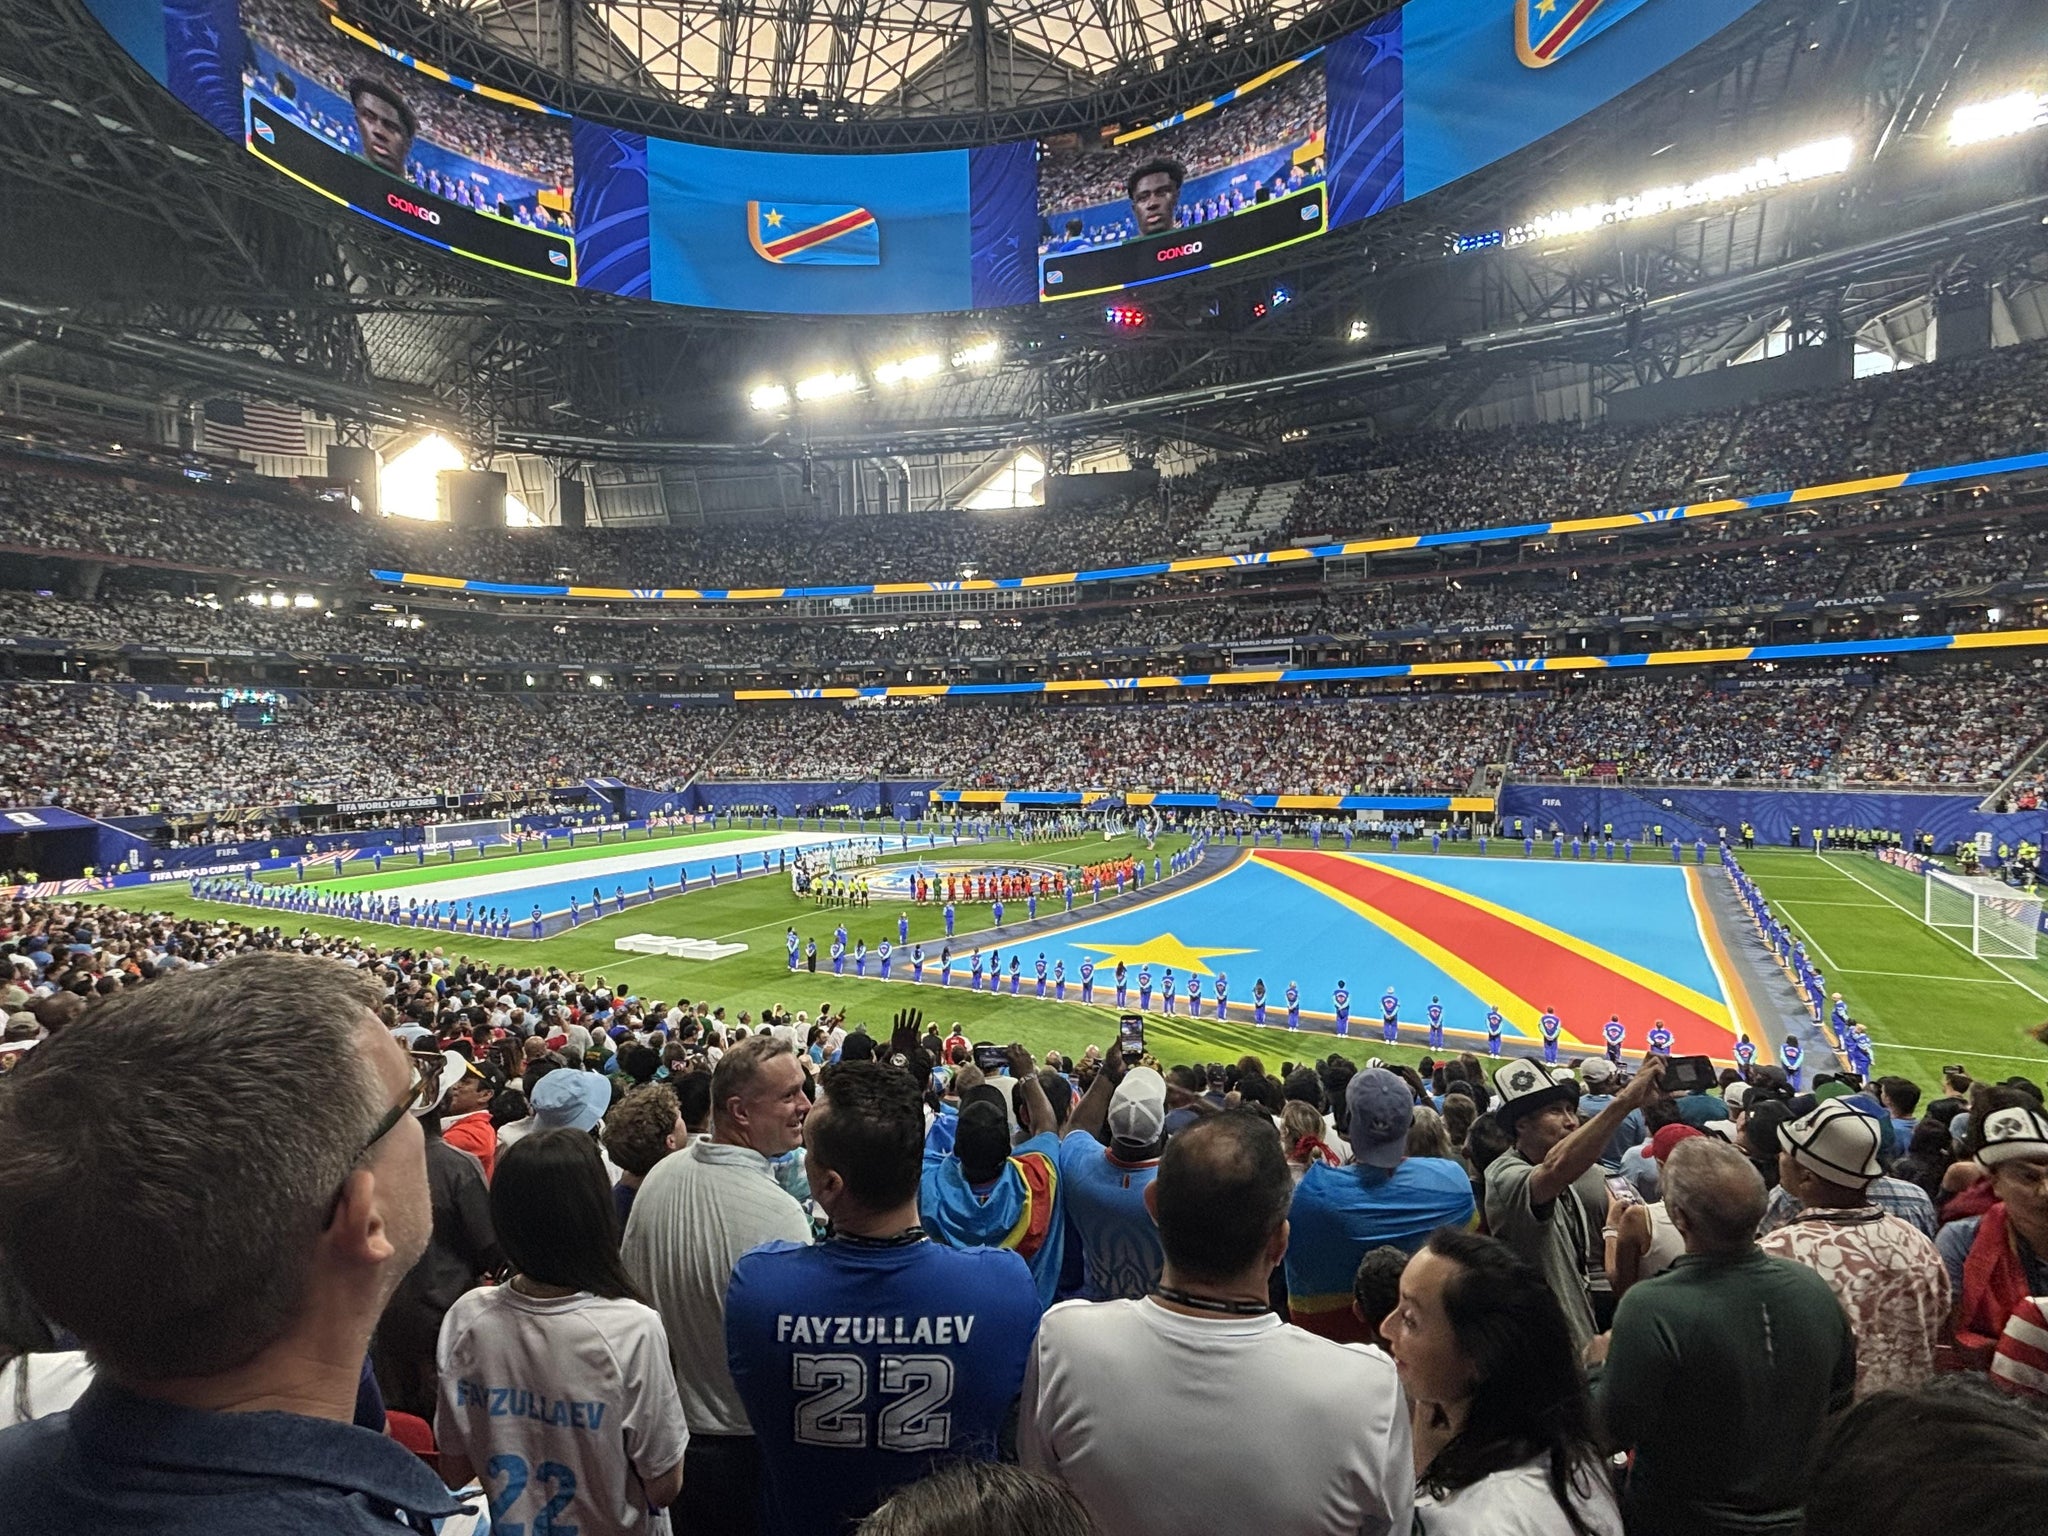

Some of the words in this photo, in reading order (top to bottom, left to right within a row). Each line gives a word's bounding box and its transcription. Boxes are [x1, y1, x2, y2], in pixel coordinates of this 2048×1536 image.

[387, 193, 441, 225] CONGO
[1157, 241, 1203, 261] CONGO
[1814, 595, 1885, 607] ATLANTA
[1462, 624, 1514, 632] ATLANTA
[1057, 650, 1092, 658] ATLANTA
[337, 804, 358, 812] FIFA
[357, 801, 390, 811] WORLD
[390, 800, 408, 808] CUP
[408, 797, 437, 807] 2026
[1542, 798, 1562, 807] FIFA
[216, 848, 240, 857] FIFA
[150, 871, 173, 881] FIFA
[209, 864, 228, 875] CUP
[777, 1314, 975, 1345] FAYZULLAEV
[793, 1353, 954, 1452] 22
[487, 1454, 579, 1536] 22
